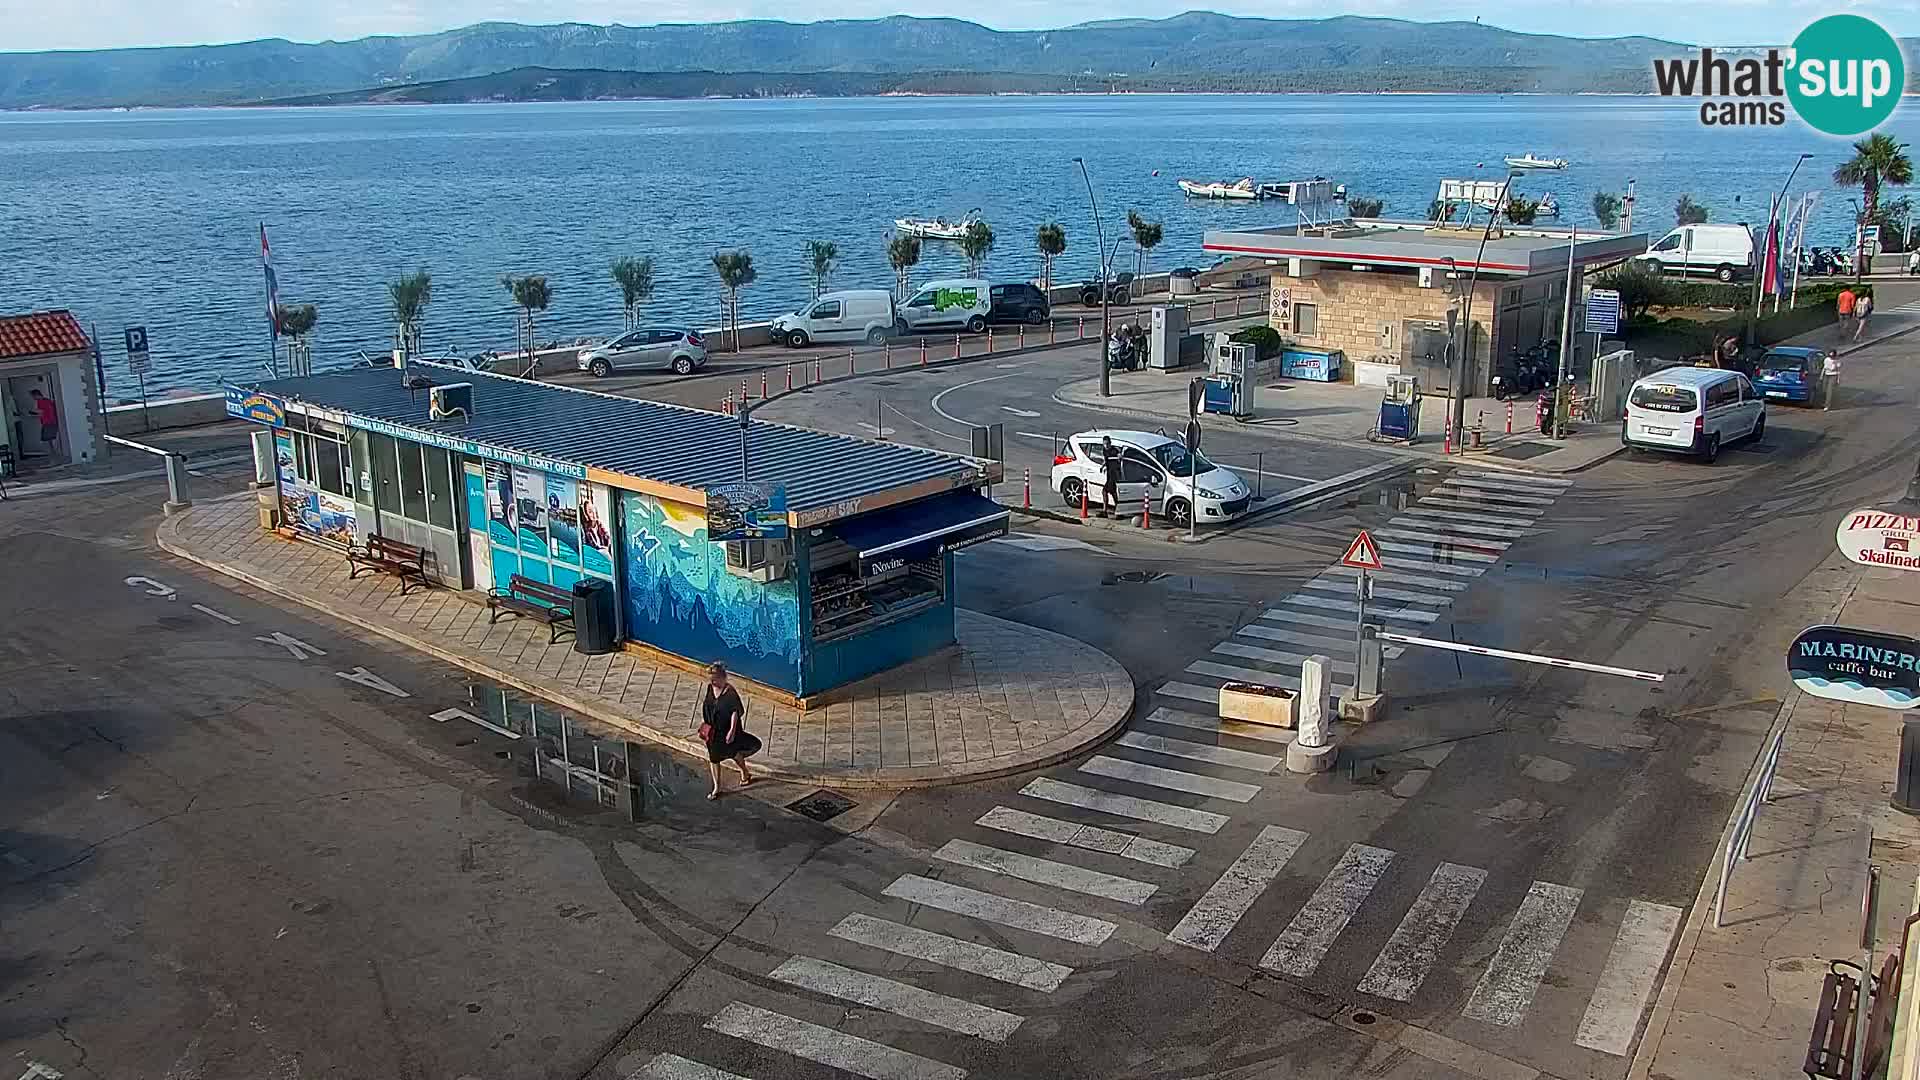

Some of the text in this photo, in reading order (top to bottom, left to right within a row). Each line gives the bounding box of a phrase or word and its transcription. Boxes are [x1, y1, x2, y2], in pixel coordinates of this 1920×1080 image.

[130, 331, 142, 349] P
[1657, 385, 1676, 395] TAXI
[395, 427, 436, 445] AUTOBUSNA
[436, 435, 468, 452] POSTAJA
[477, 446, 493, 457] BUS
[493, 449, 527, 464] STATION
[528, 456, 554, 470] TICKET
[555, 463, 582, 477] OFFICE
[1848, 514, 1920, 532] PIZZE
[1880, 529, 1917, 540] GRILL
[1869, 665, 1896, 680] bar
